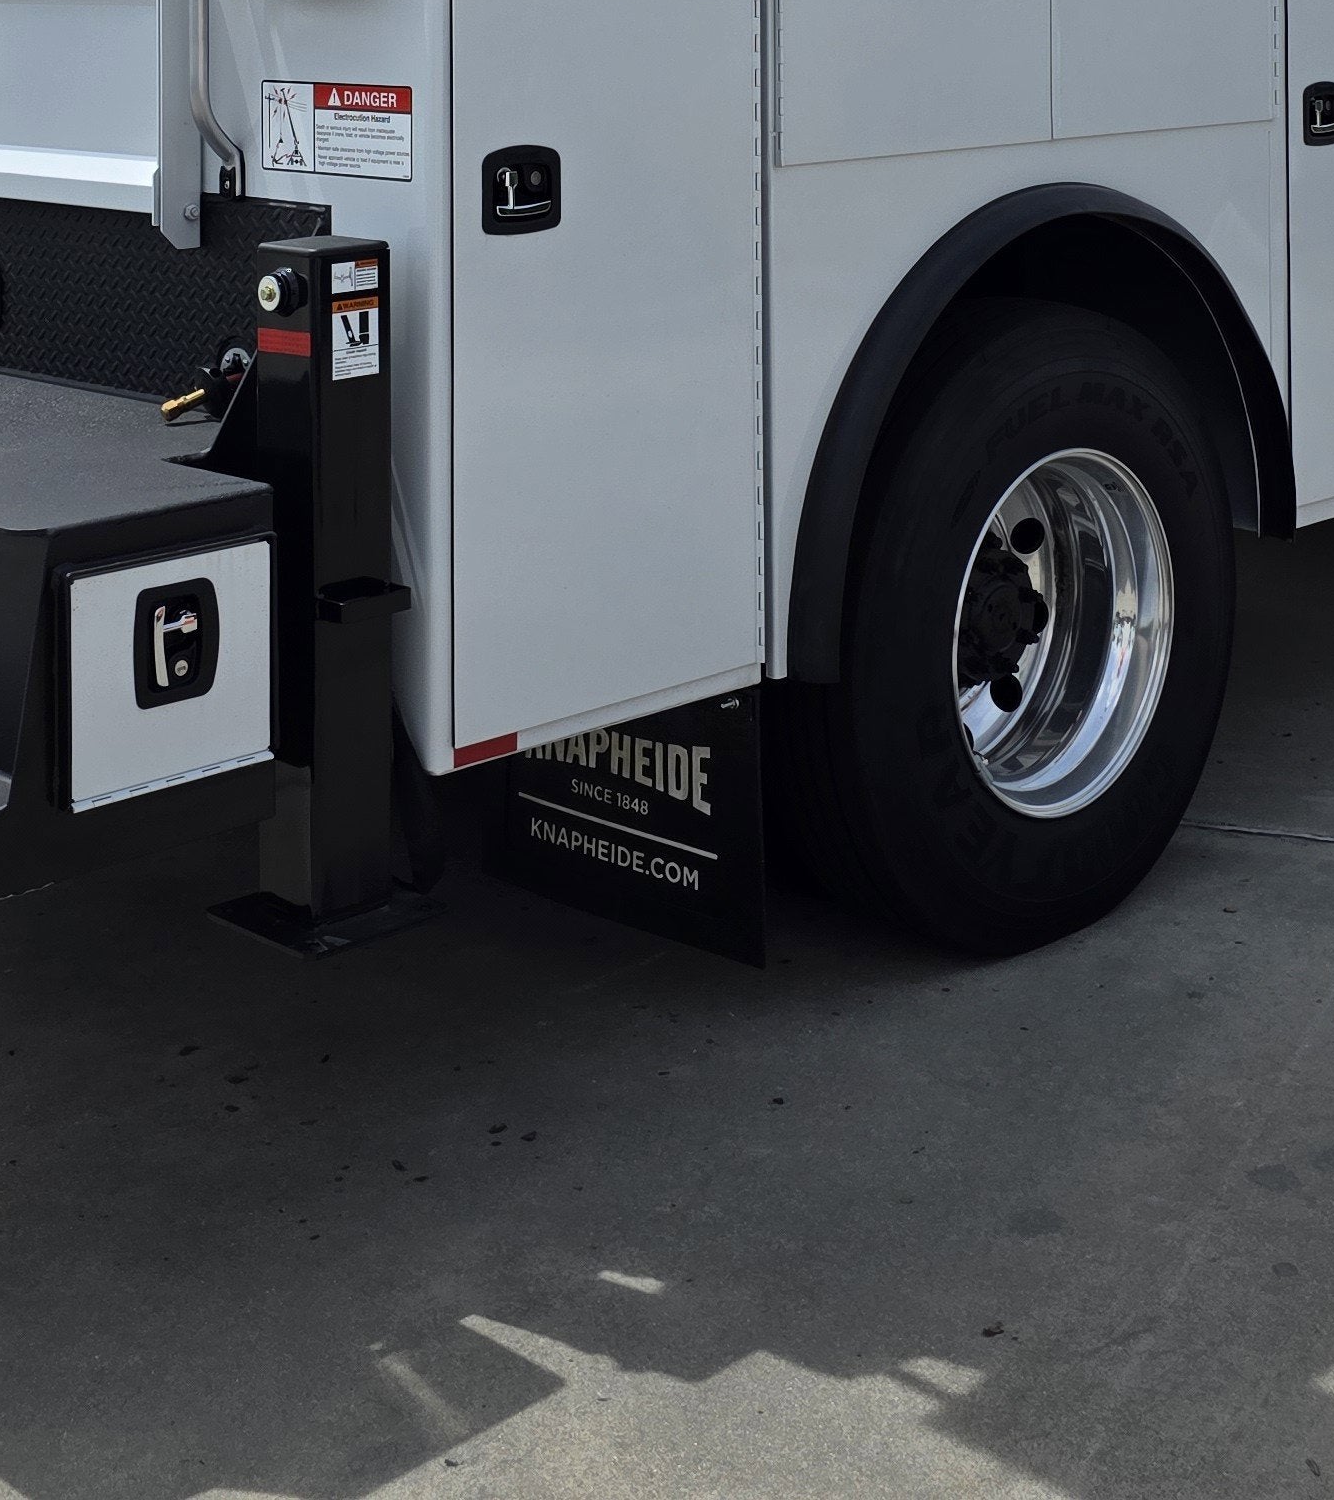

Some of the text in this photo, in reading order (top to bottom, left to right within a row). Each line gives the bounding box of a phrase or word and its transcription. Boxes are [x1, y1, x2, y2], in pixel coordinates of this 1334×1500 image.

[344, 91, 397, 107] DANGER
[334, 113, 390, 123] Electrocution Hazard
[525, 728, 711, 816] APHEIDE
[571, 779, 649, 815] SINCE 1848
[531, 817, 699, 890] KNAPHEIDE.COM
